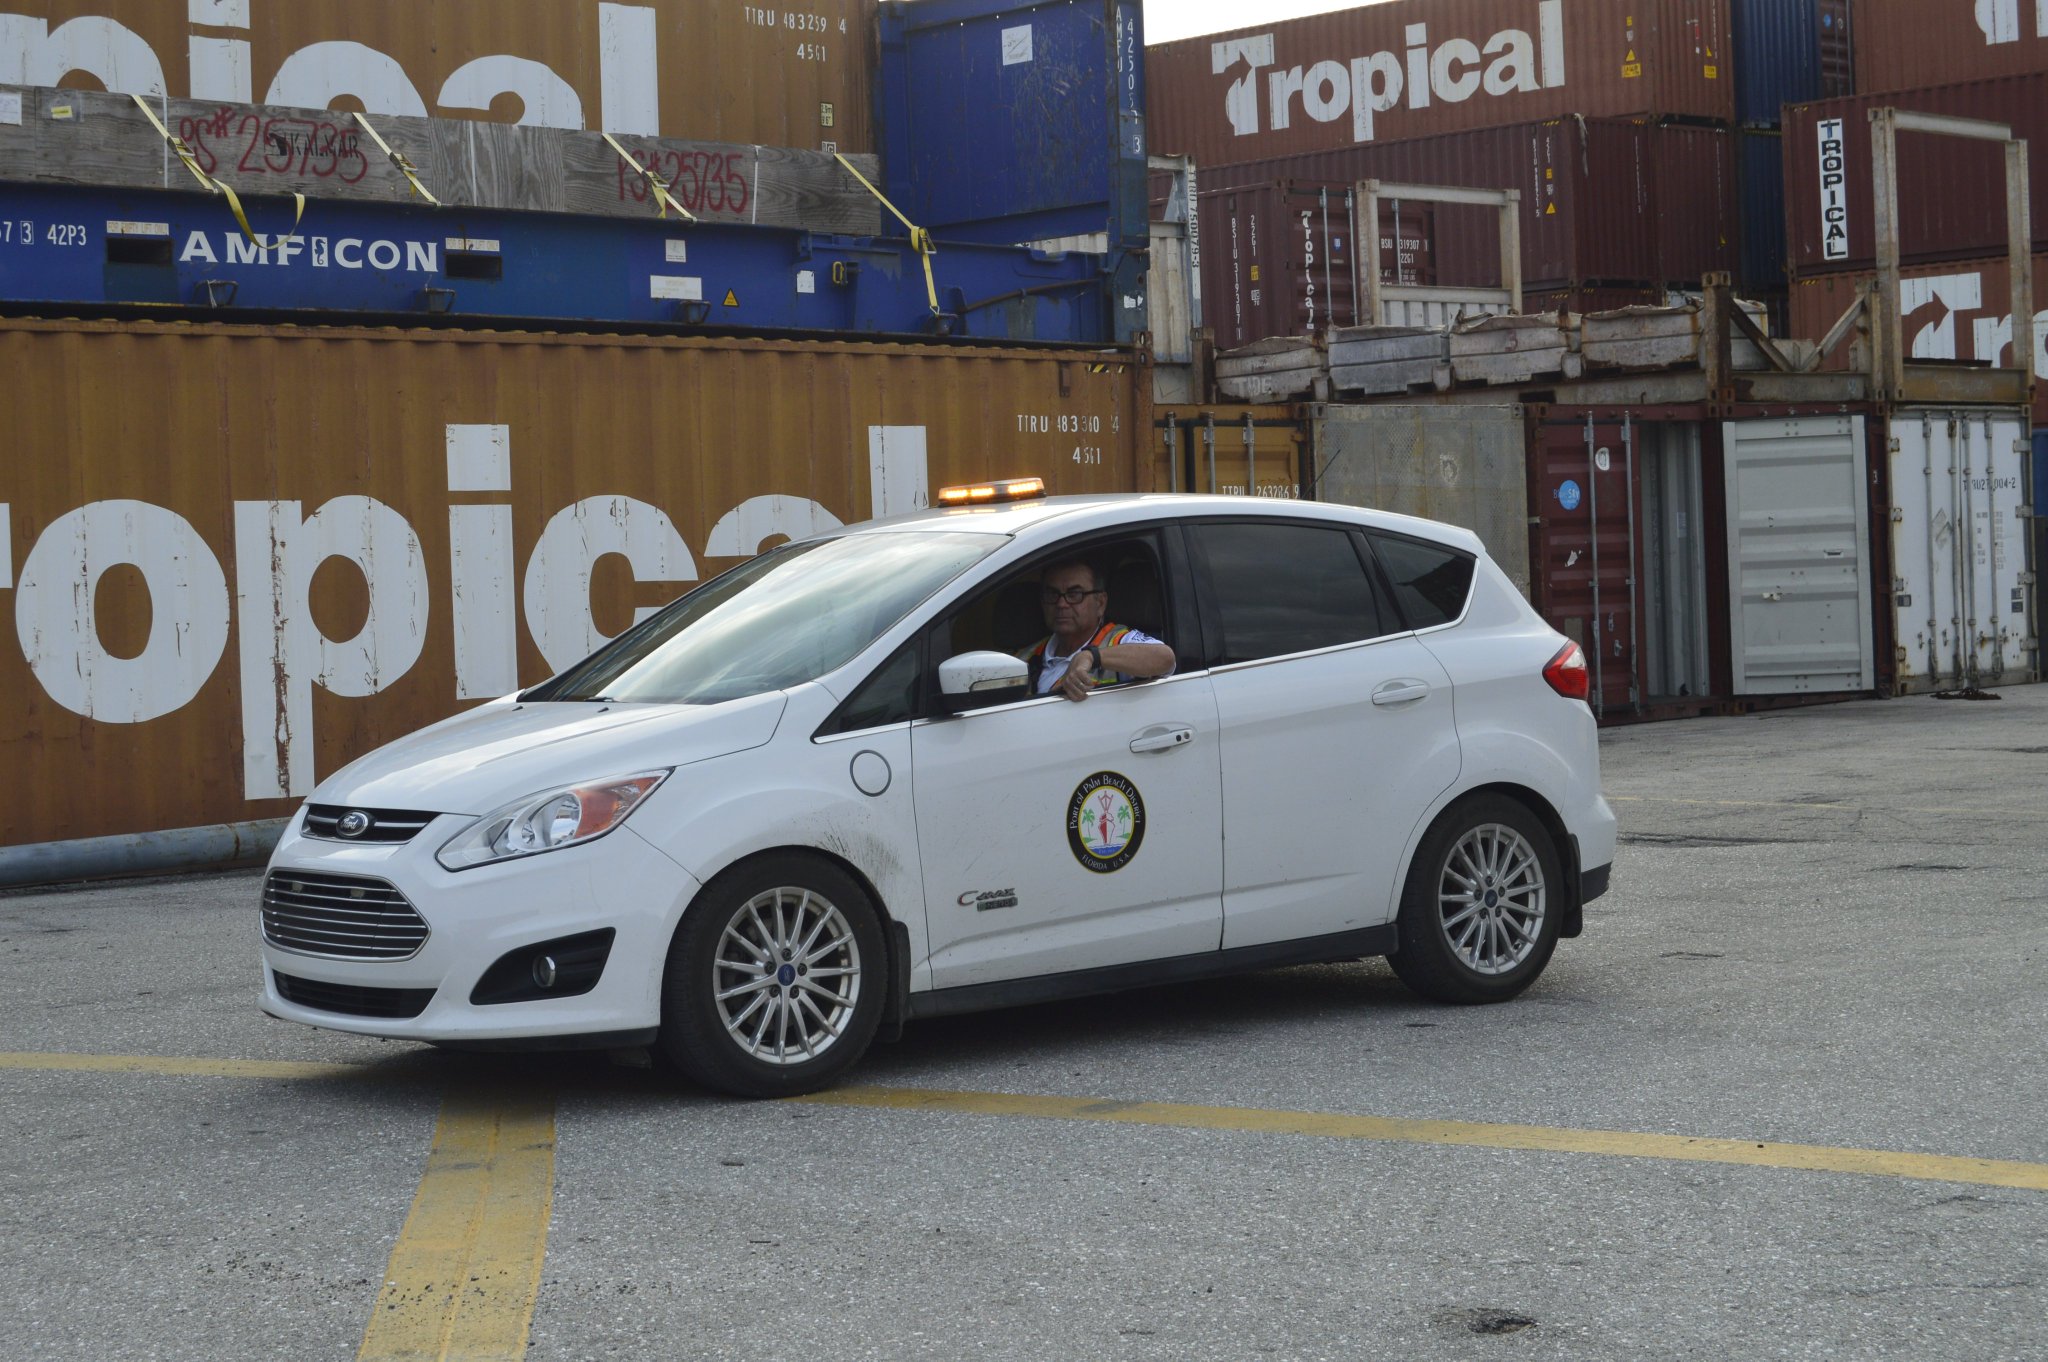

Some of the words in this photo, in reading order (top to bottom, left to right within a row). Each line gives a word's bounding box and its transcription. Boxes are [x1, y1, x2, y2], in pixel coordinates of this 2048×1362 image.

[745, 7, 775, 26] TTRU
[1211, 0, 1565, 142] Tropical
[1820, 121, 1846, 257] TROPICAL
[48, 224, 87, 246] 42P3
[1301, 210, 1315, 329] Tropical
[1017, 414, 1048, 432] TTRU
